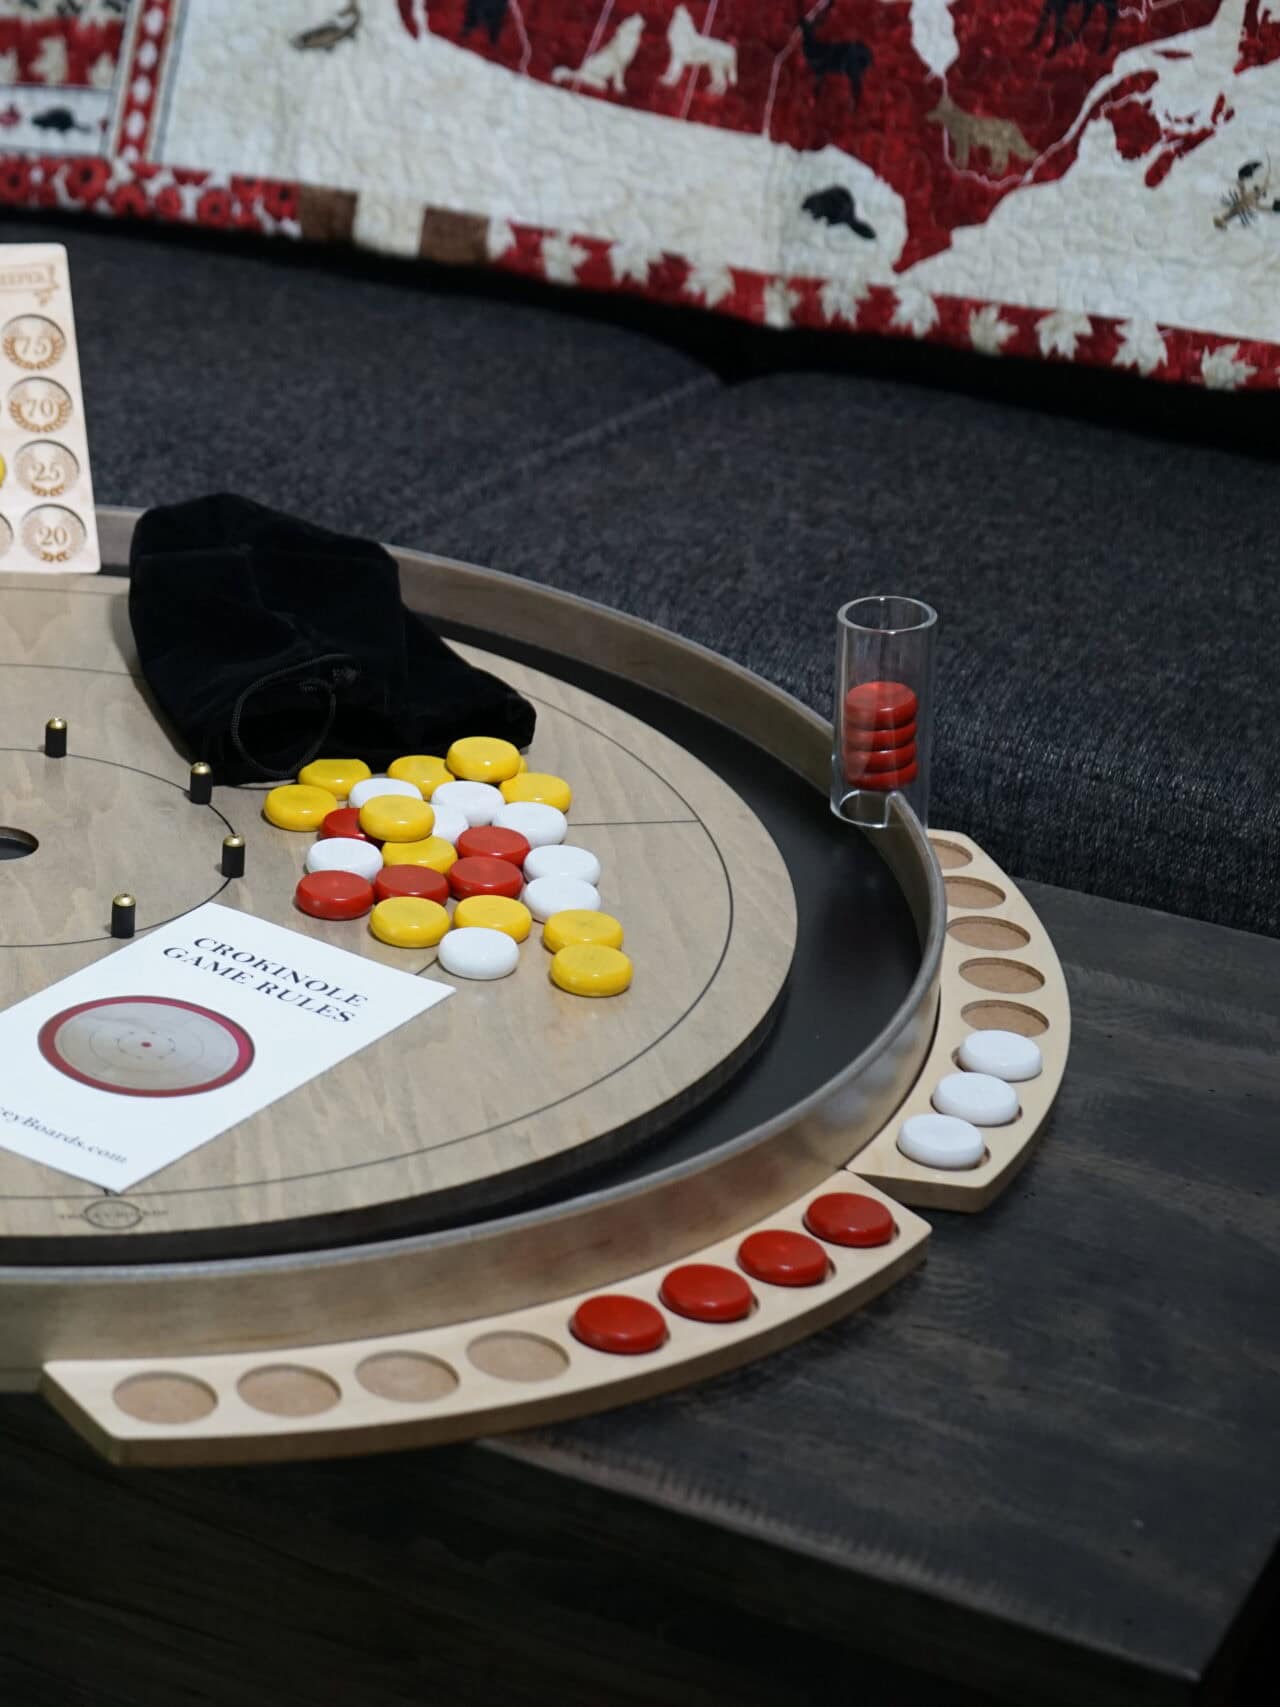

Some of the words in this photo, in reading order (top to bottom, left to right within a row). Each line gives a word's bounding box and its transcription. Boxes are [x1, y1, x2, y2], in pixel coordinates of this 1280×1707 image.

[19, 336, 48, 355] 75
[24, 399, 54, 418] 70
[32, 462, 61, 482] 25
[38, 525, 68, 546] 20
[194, 936, 369, 1008] CROKINOLE
[163, 946, 254, 985] GAME
[256, 980, 356, 1023] RULES
